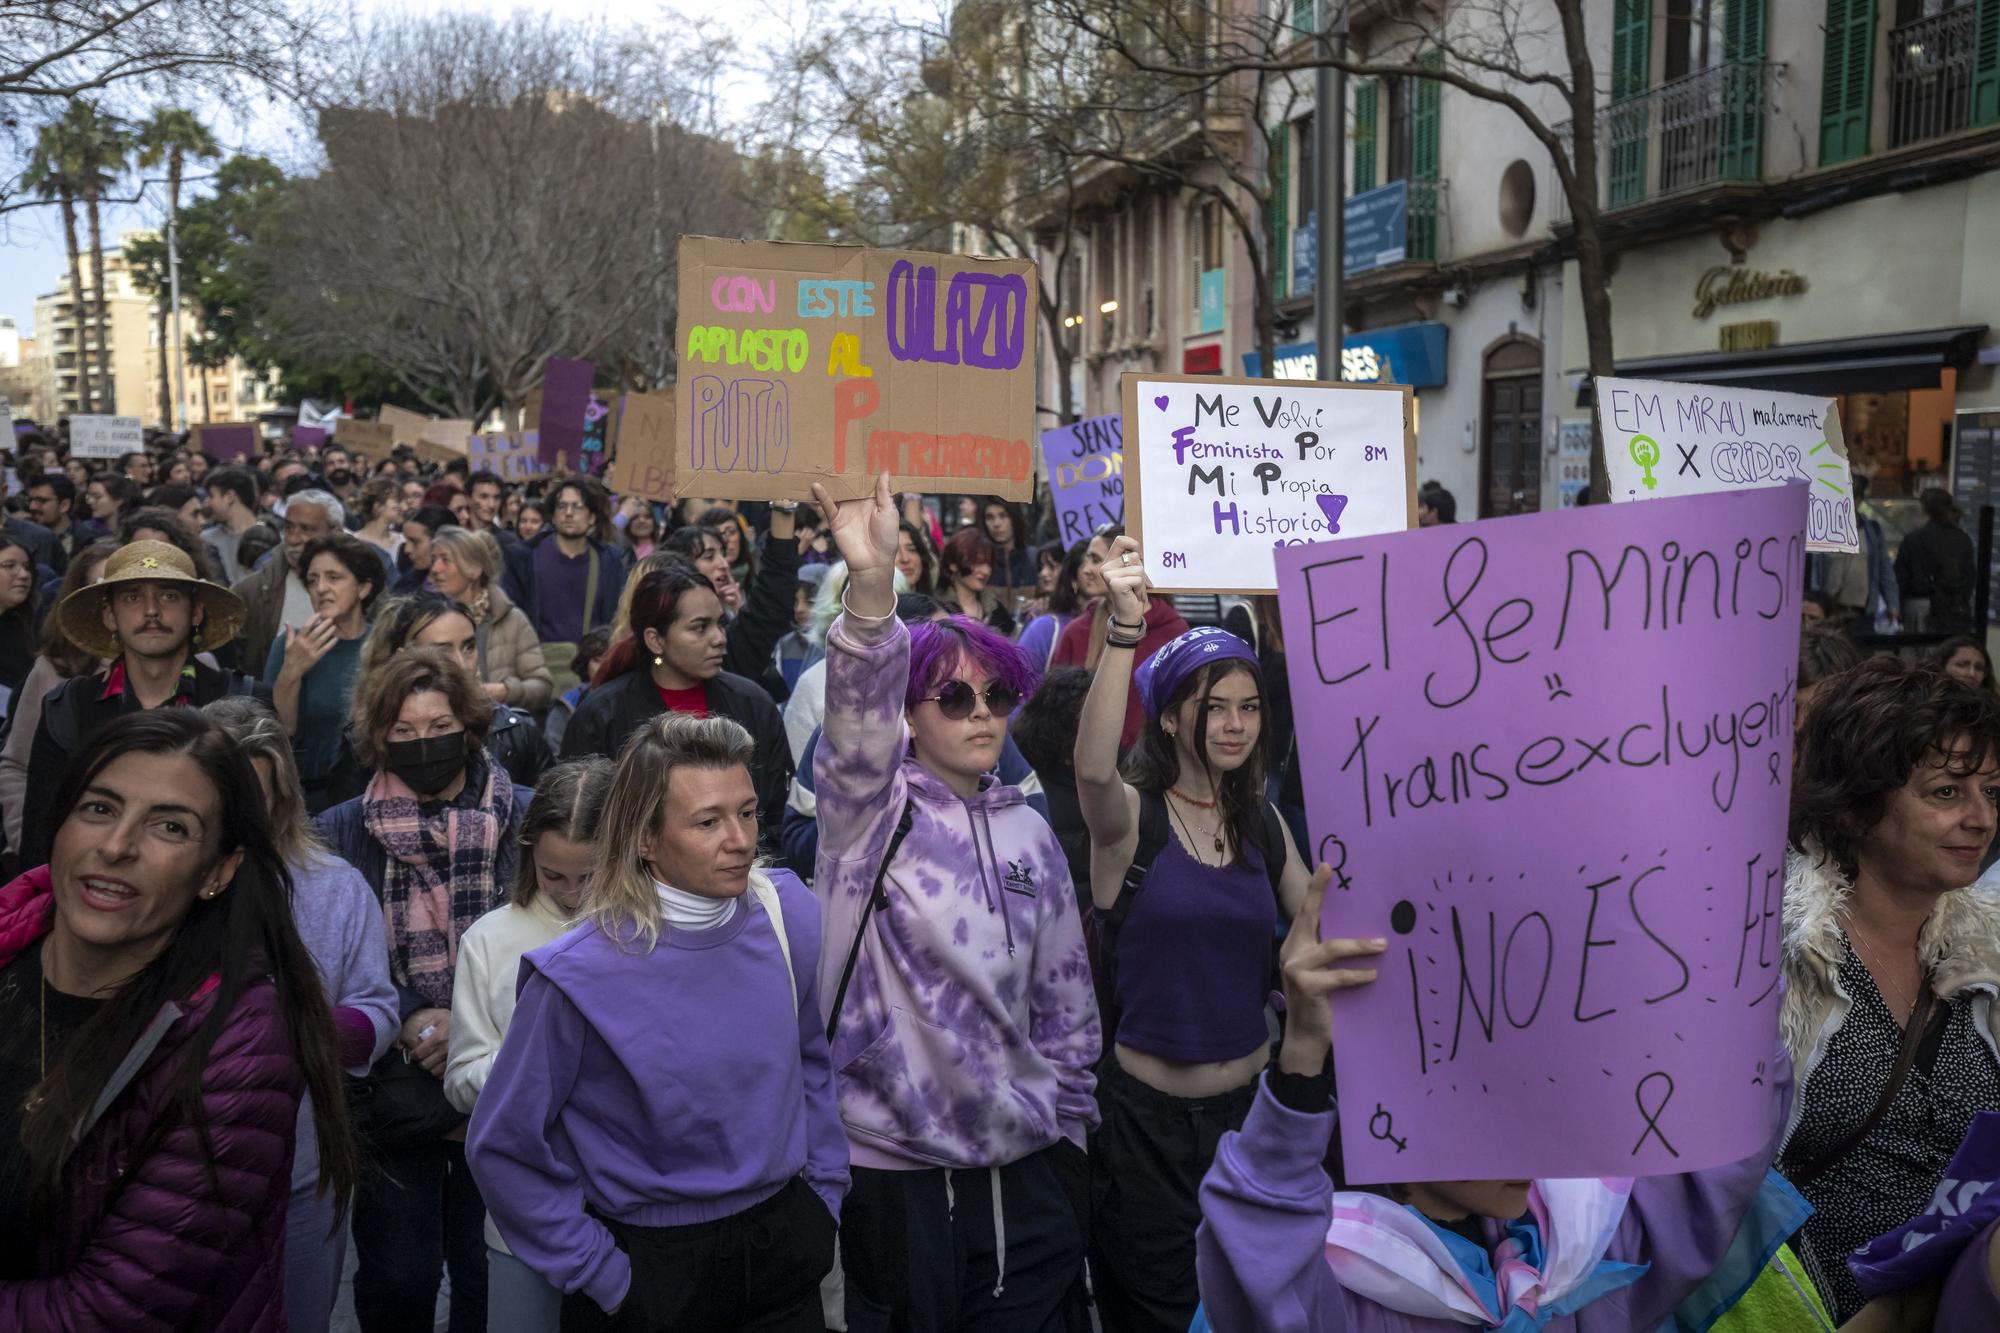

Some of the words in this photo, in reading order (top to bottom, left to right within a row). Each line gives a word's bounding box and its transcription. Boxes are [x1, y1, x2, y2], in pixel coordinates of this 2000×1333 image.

[710, 275, 776, 314] CON
[797, 279, 876, 318] ESTE
[687, 325, 809, 373] APLASTO
[827, 331, 873, 377] AL
[691, 375, 789, 474] PUTO
[1194, 393, 1240, 428] Me
[1612, 390, 1665, 433] EM
[1753, 402, 1822, 430] malament
[1171, 425, 1284, 465] Feminista
[1294, 431, 1336, 461] Por
[1364, 445, 1388, 461] 8M
[1188, 463, 1236, 497] Mi
[1253, 462, 1334, 502] Propia
[1162, 552, 1187, 569] 8M
[1302, 552, 1390, 684] El
[1573, 866, 1689, 1022] ES
